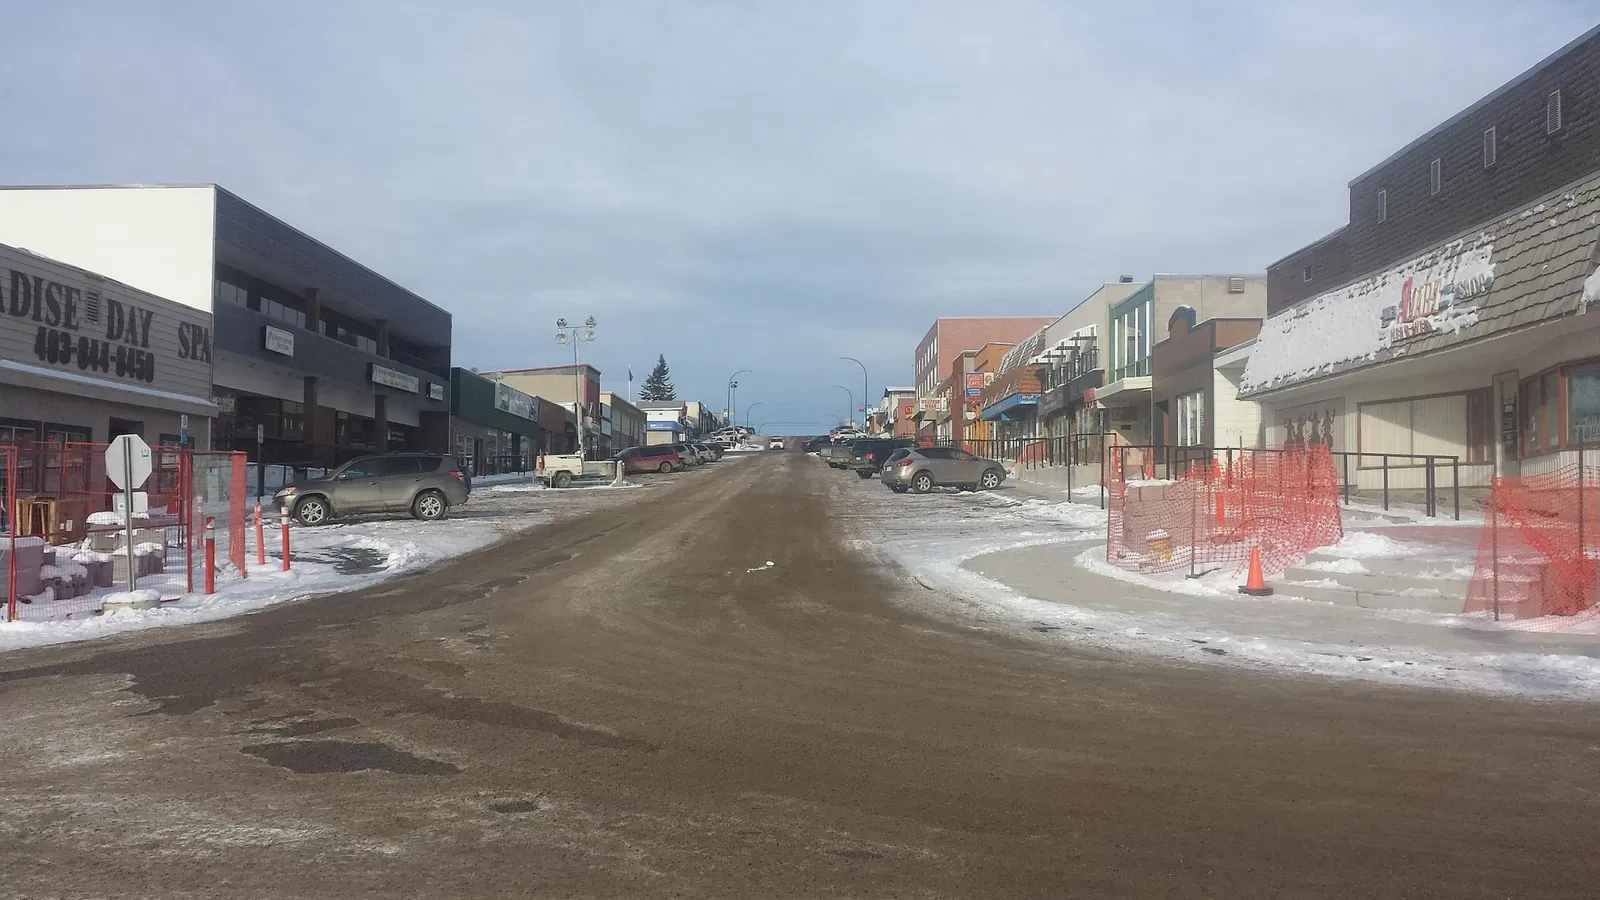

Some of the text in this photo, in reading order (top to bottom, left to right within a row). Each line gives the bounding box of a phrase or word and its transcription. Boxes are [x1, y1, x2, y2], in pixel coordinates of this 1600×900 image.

[0, 268, 211, 364] DISE DAY SPA
[34, 325, 155, 383] 403-844-8450
